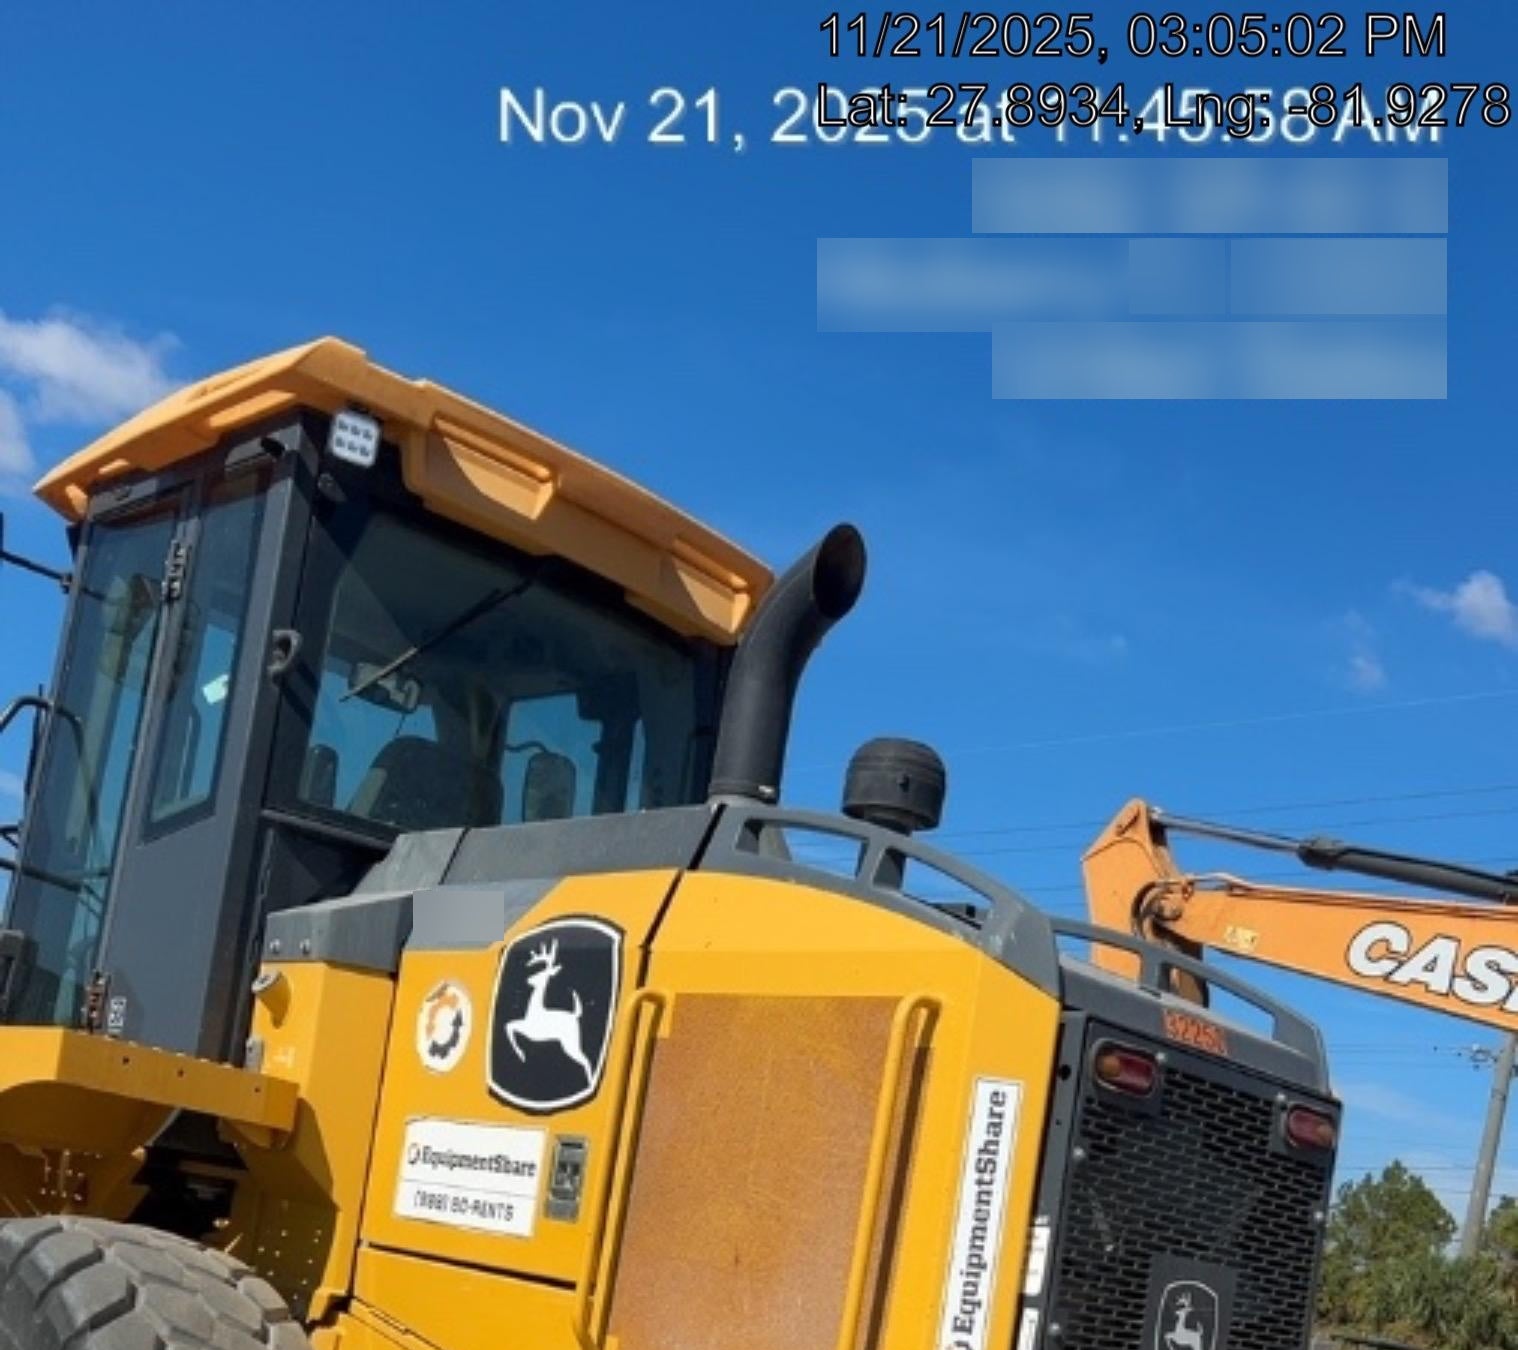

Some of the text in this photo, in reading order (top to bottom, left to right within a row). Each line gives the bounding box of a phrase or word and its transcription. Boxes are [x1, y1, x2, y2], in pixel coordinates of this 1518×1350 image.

[1345, 920, 1518, 1013] CAS
[422, 1146, 536, 1177] EquipmentShare
[952, 1090, 1006, 1336] EquipmentShare
